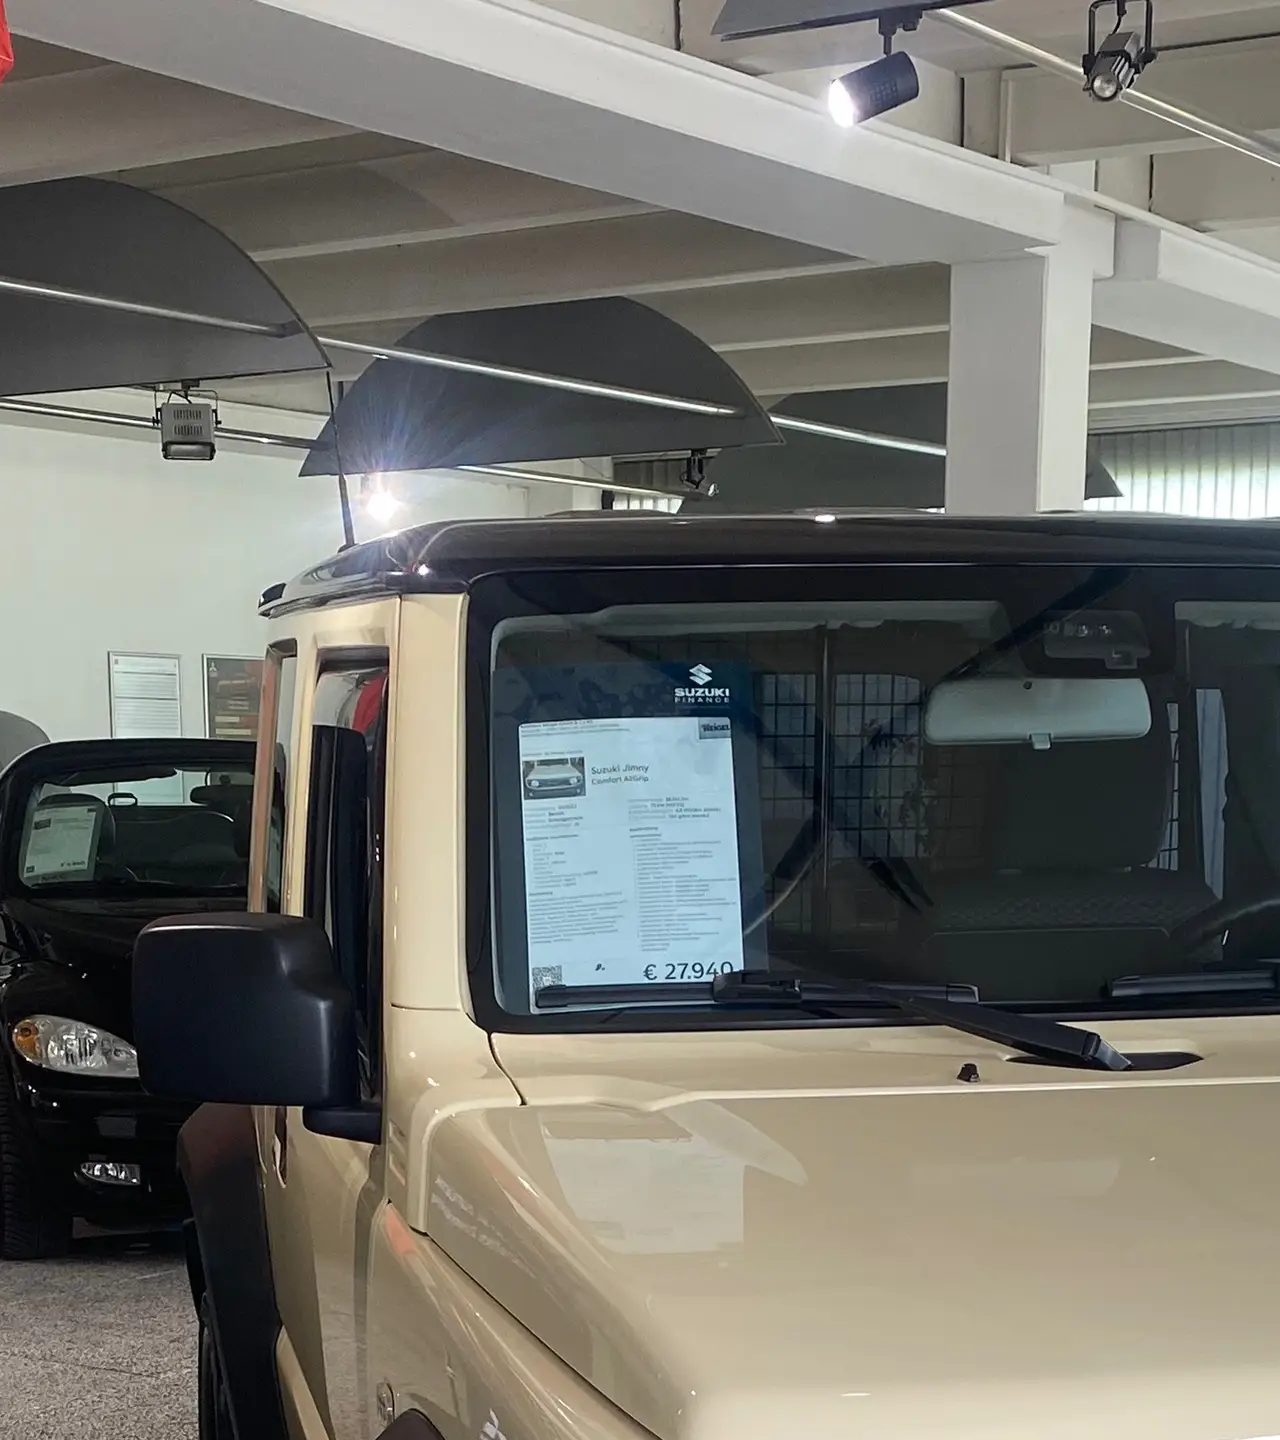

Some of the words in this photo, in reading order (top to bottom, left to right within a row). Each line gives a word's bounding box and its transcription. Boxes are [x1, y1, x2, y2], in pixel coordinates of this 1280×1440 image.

[674, 688, 730, 697] SUZUKI
[591, 766, 620, 775] Suzuki
[623, 764, 649, 775] Jimny
[591, 776, 622, 785] Comfort
[643, 963, 658, 981] €
[664, 961, 734, 981] 27.940
